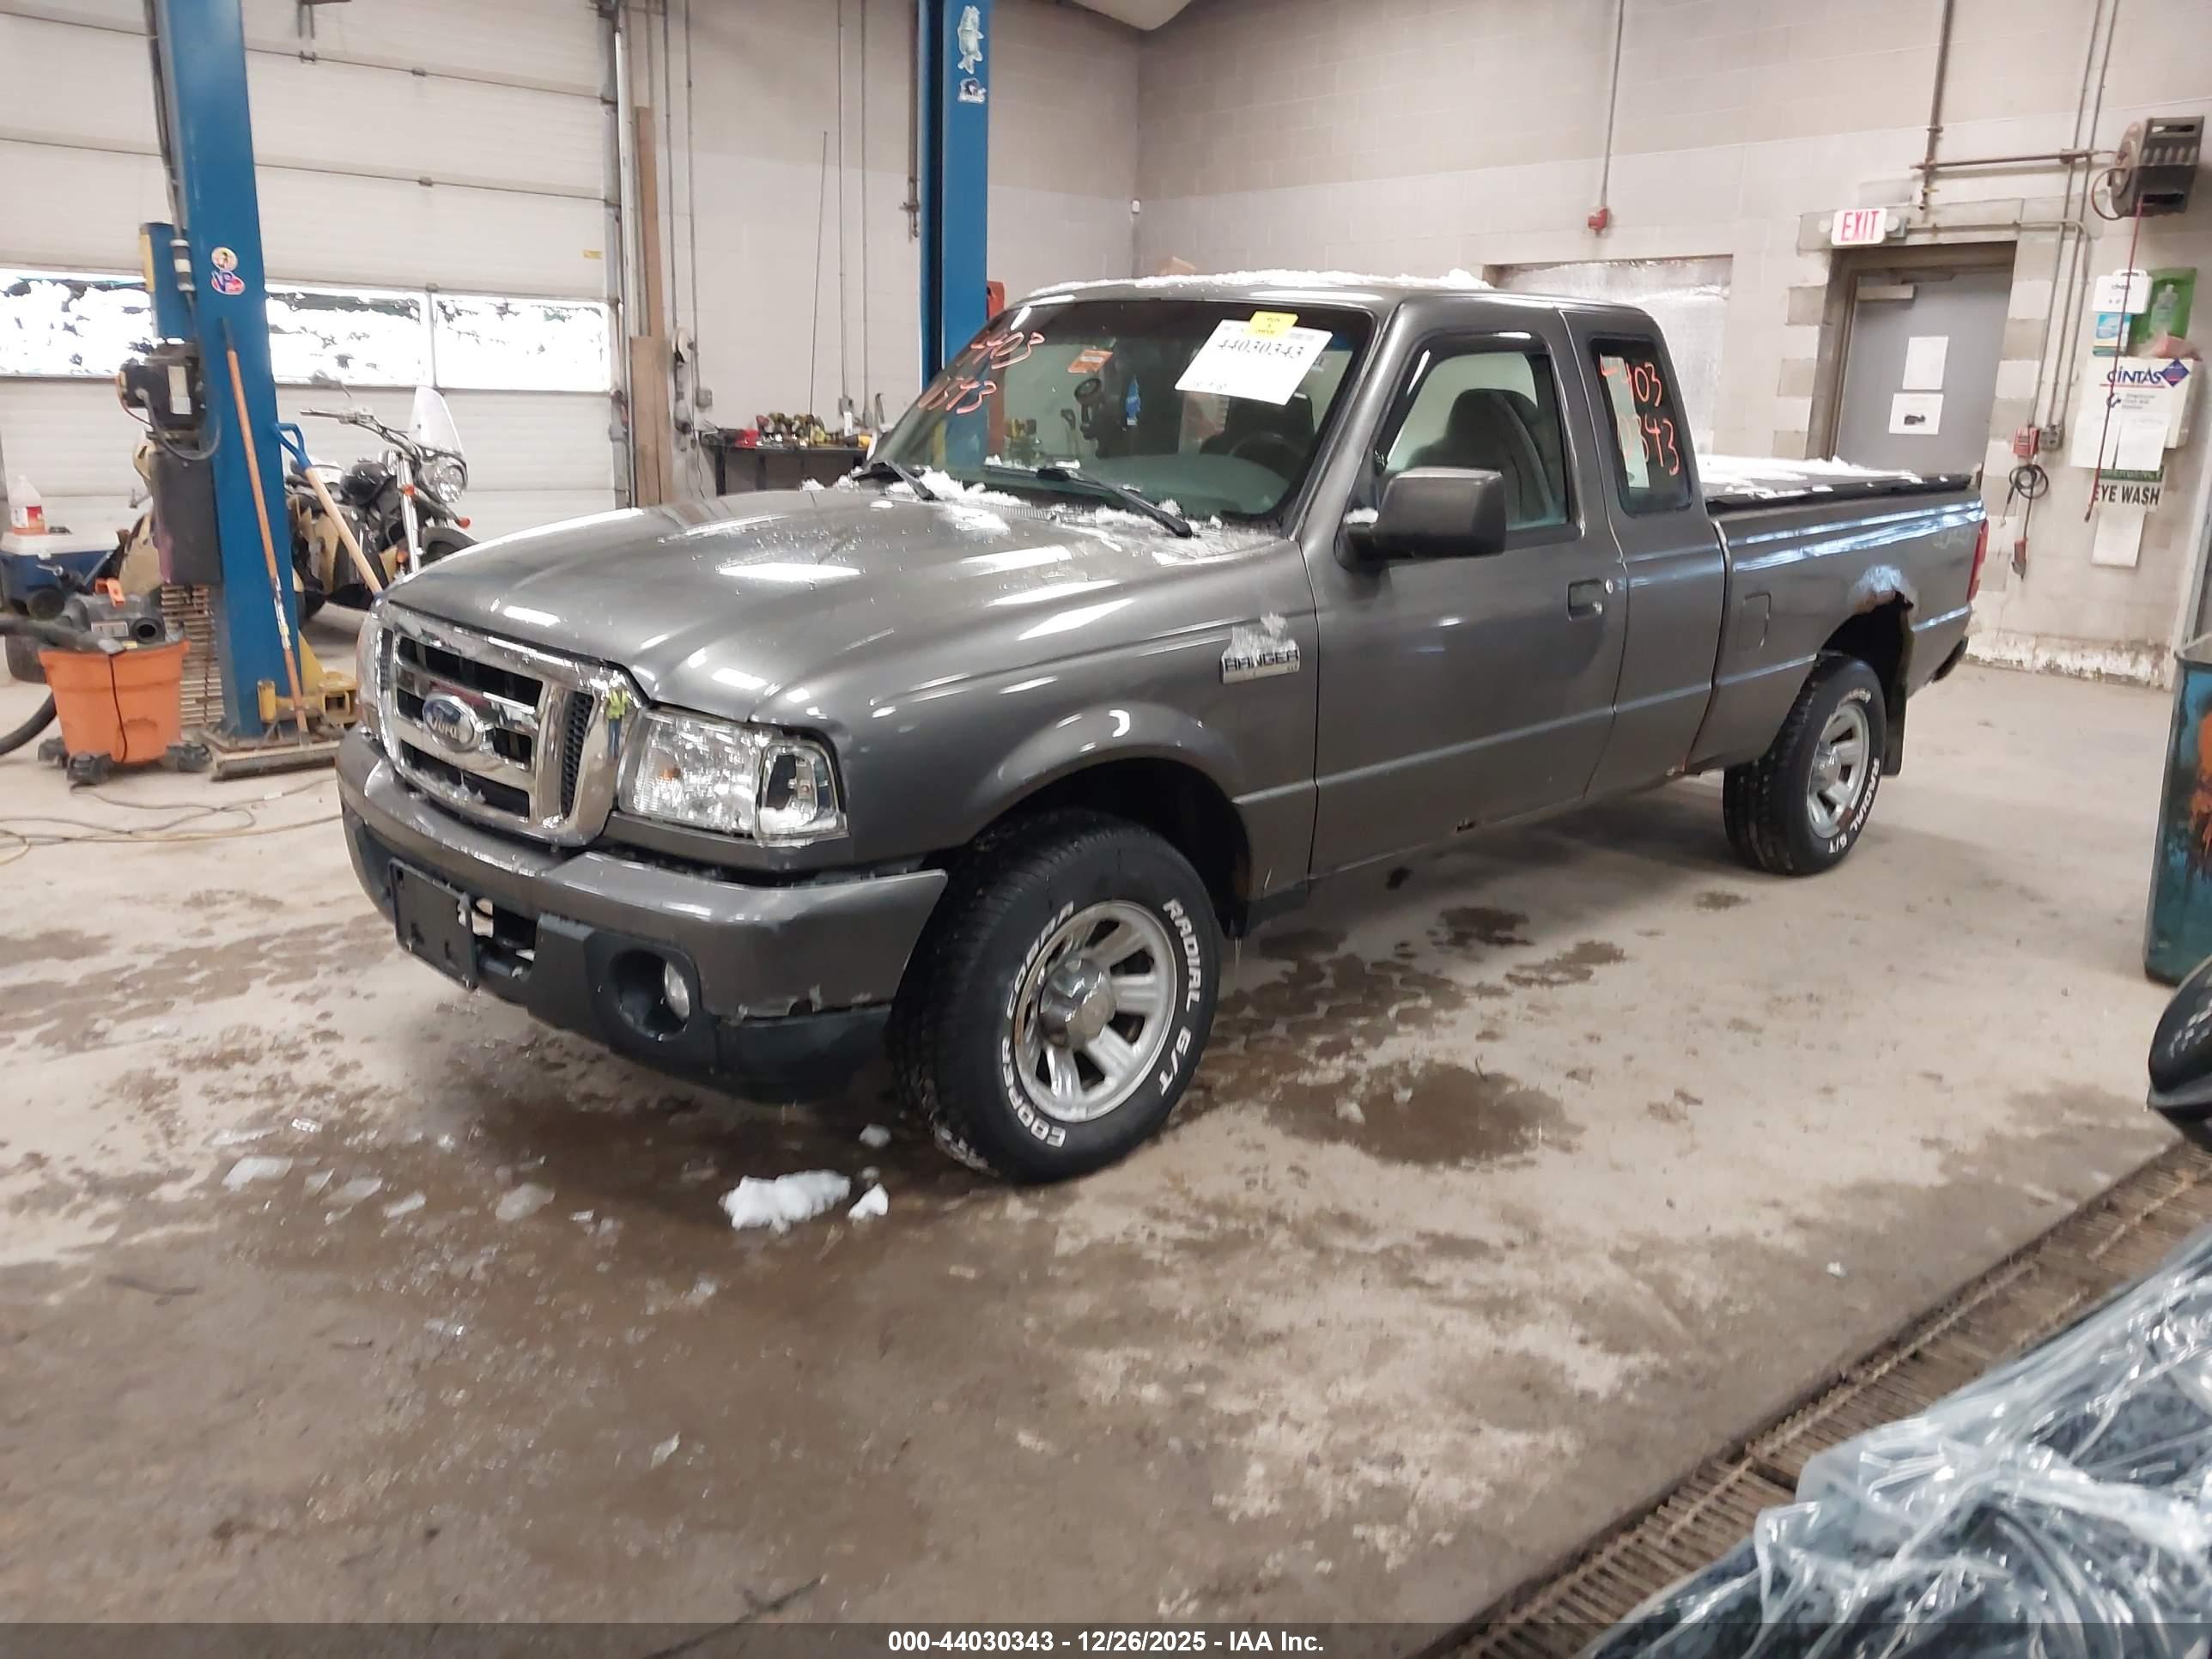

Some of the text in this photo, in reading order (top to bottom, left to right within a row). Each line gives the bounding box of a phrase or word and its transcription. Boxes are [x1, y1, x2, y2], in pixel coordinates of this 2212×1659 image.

[1840, 210, 1880, 242] EXIT
[1218, 338, 1304, 359] 44030343
[2106, 365, 2162, 385] CINTAS
[2092, 484, 2161, 506] EYE WASH
[1849, 757, 1881, 832] RADIAL
[1158, 898, 1202, 1097] RADIAL G/T
[1001, 1036, 1066, 1148] COOPER
